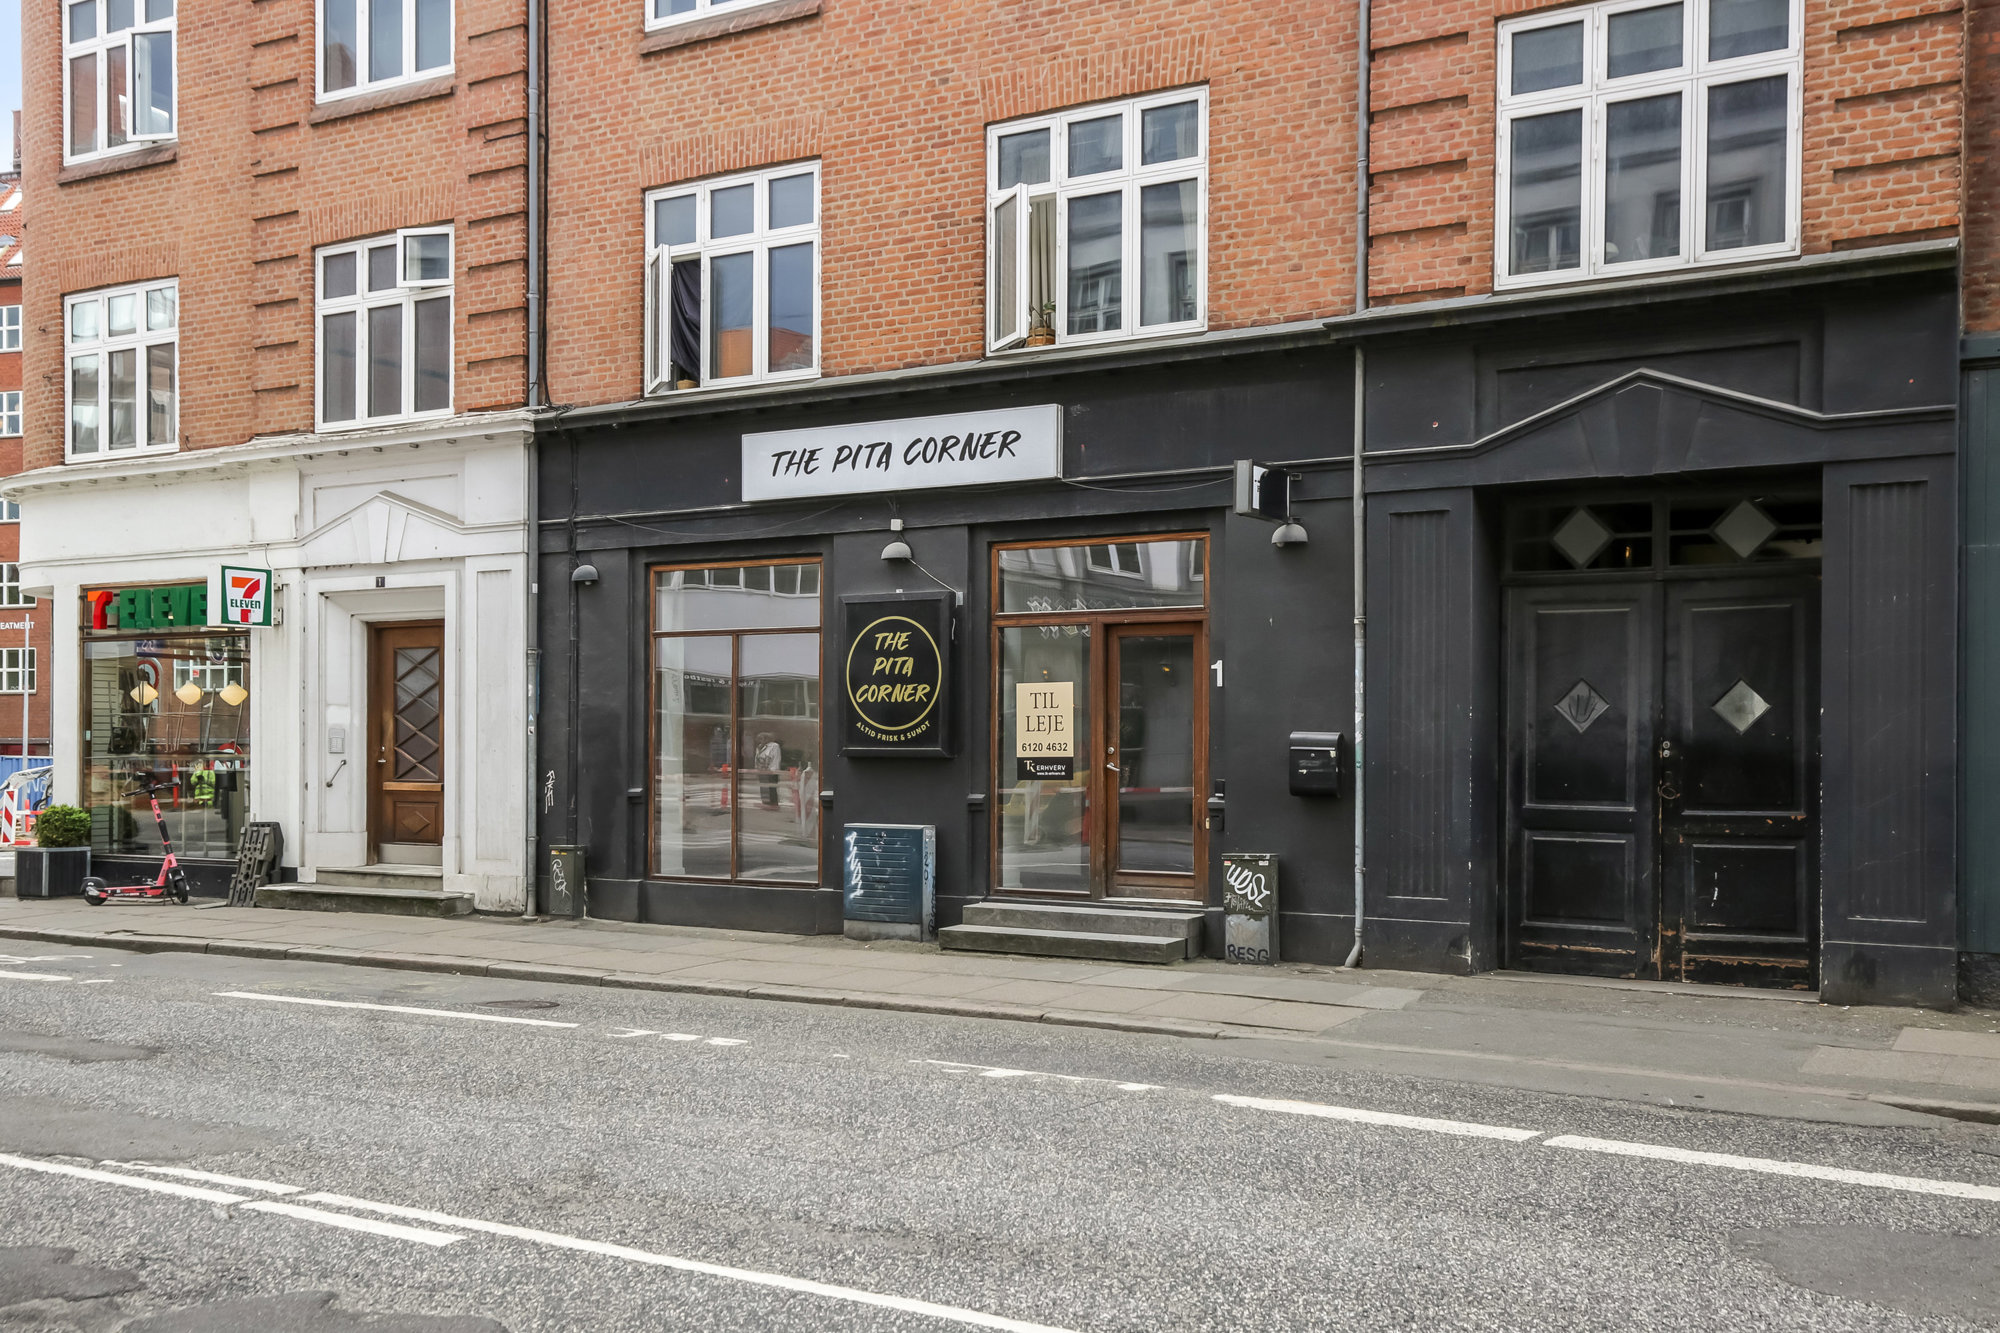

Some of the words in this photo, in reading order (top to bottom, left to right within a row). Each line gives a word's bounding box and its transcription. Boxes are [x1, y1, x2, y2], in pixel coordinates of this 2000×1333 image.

[771, 447, 824, 477] THE
[832, 441, 893, 472] PITA
[903, 430, 1022, 466] CORNER
[87, 585, 207, 630] 7-ELEVE
[874, 631, 913, 651] THE
[872, 656, 914, 677] PITA
[1210, 659, 1223, 687] 1
[855, 683, 931, 703] CORNER
[1029, 692, 1060, 709] TIL
[855, 721, 876, 738] ALTID
[877, 732, 899, 742] FRISK
[900, 732, 906, 741] &
[906, 720, 931, 739] SUNDT
[1025, 714, 1065, 736] LEJE
[1021, 742, 1043, 752] 6120
[1046, 742, 1068, 752] 4632
[1036, 764, 1066, 772] ERHVERV
